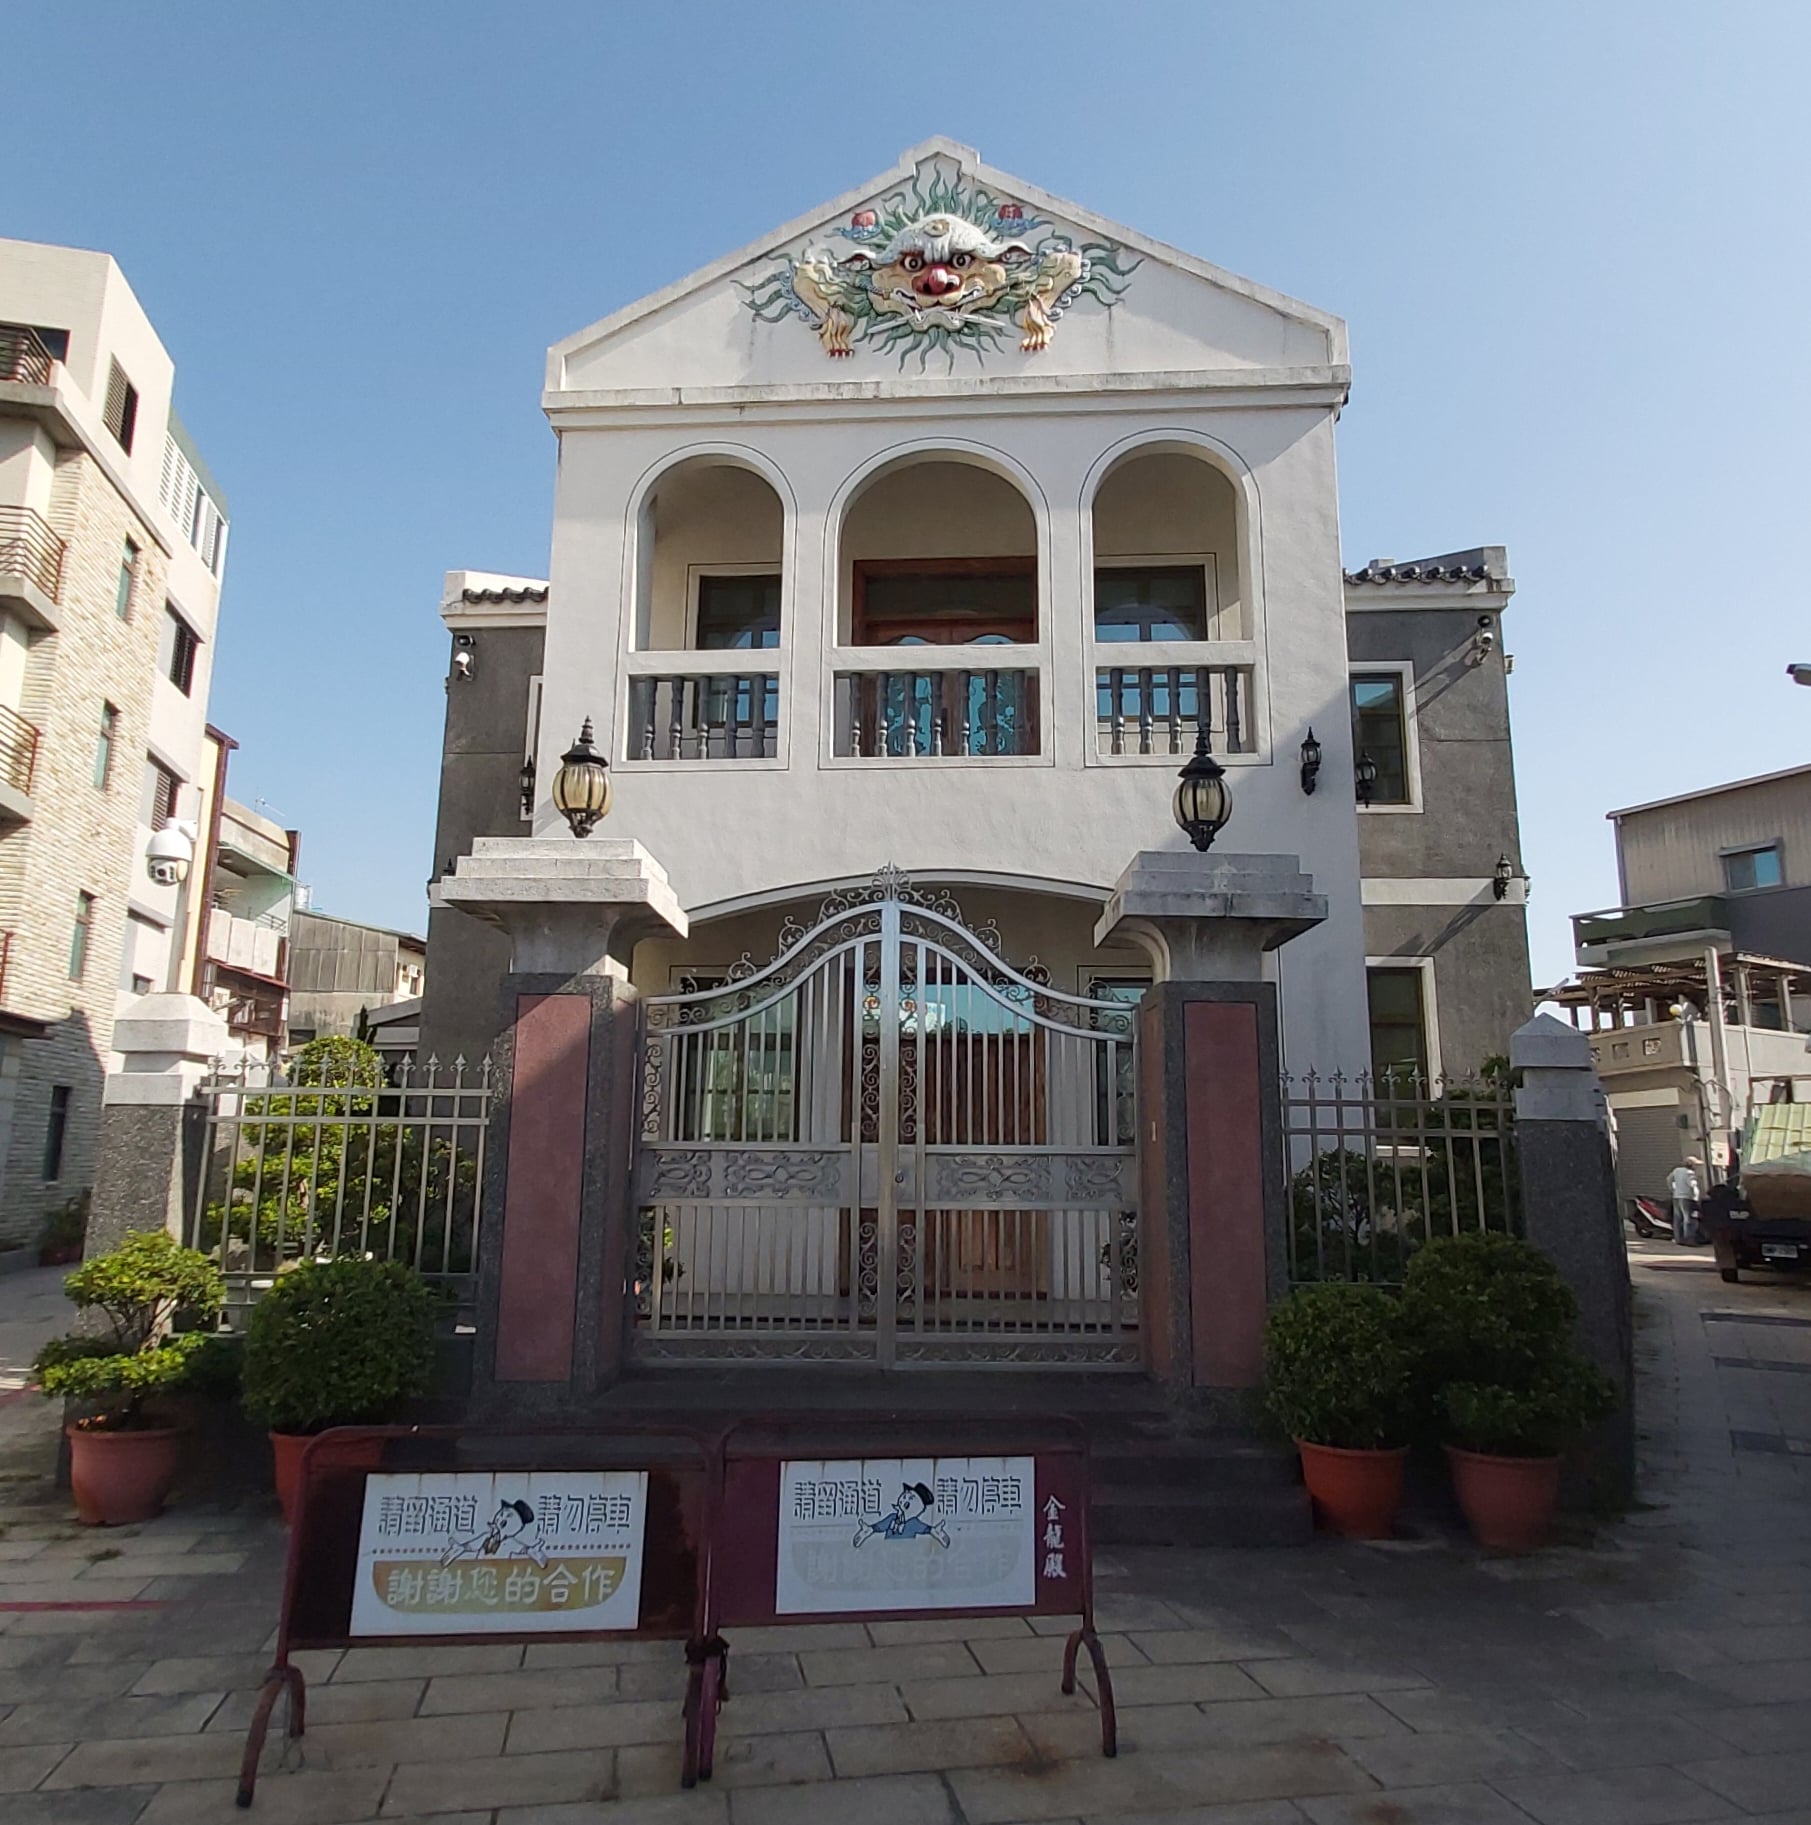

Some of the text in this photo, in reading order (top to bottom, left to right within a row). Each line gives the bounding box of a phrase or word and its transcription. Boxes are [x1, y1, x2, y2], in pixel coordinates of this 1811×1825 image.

[379, 1494, 632, 1535] 請留通道 請勿停車
[793, 1476, 1022, 1520] 請留通道 請勿停車
[1043, 1495, 1067, 1578] 金龍殿
[387, 1563, 616, 1605] 謝謝您的合作
